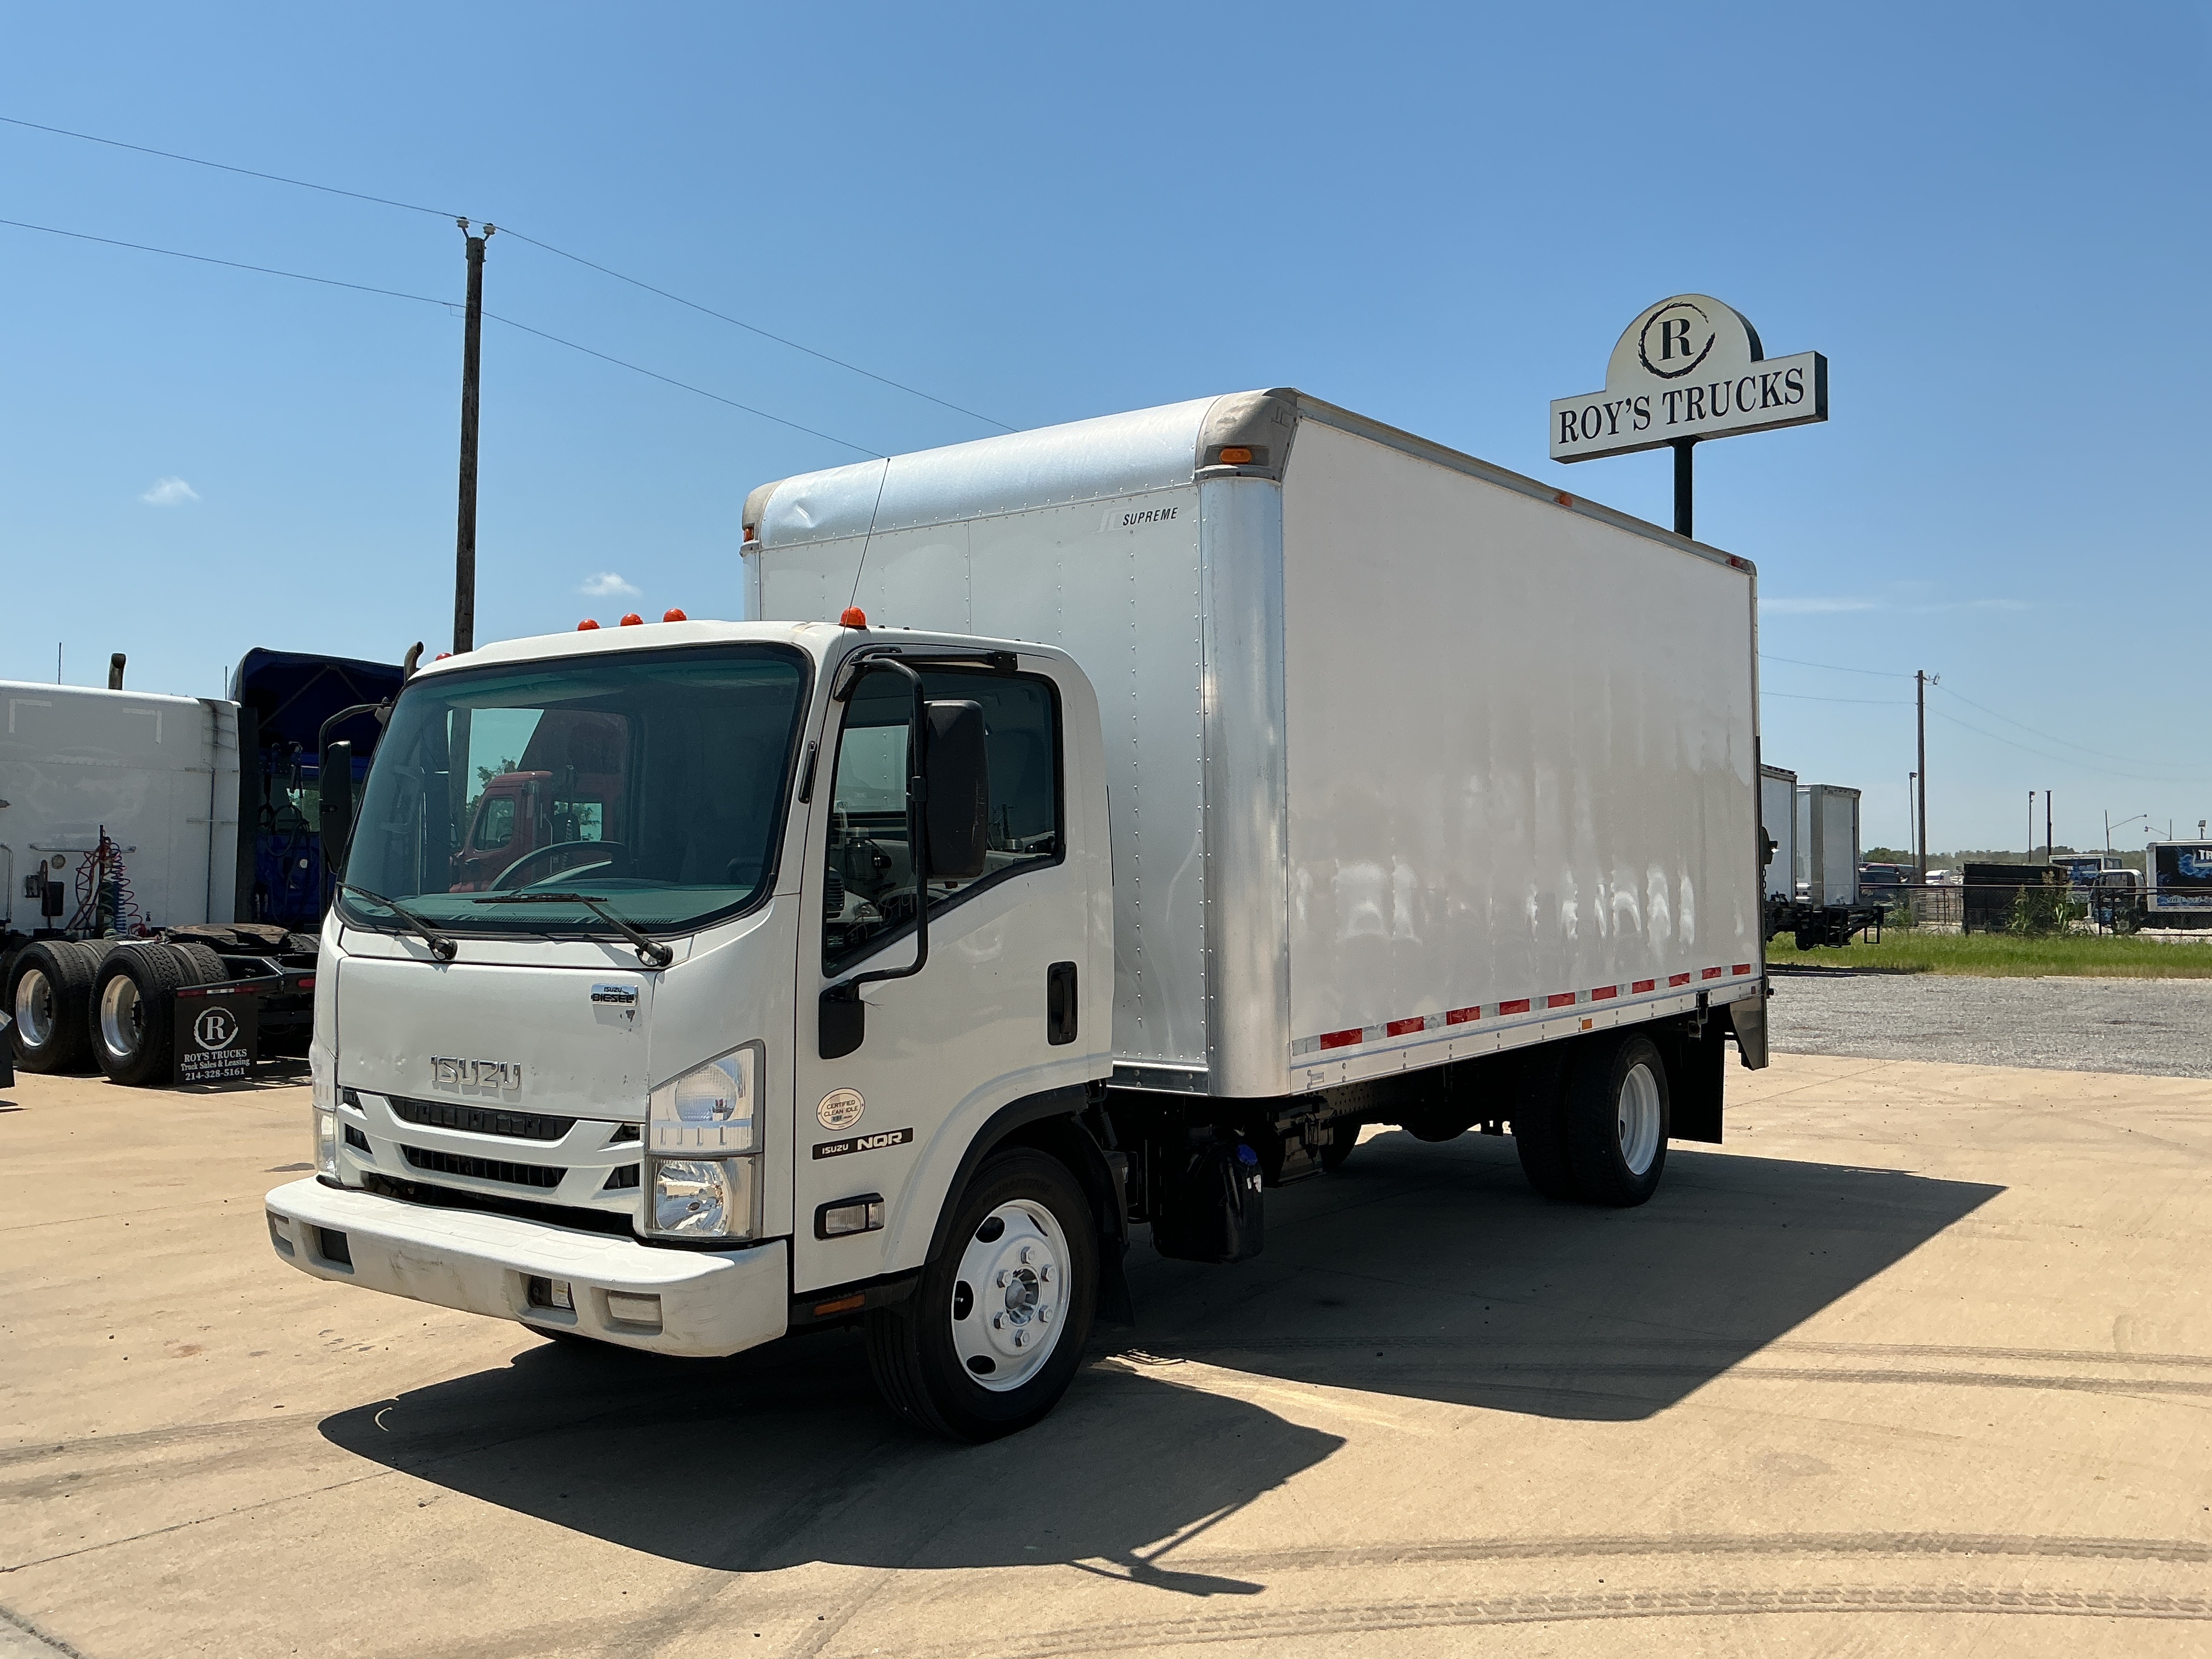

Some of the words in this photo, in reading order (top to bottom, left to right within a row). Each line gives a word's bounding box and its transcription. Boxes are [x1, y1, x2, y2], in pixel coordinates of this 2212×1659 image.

[1658, 318, 1695, 362] R
[1558, 394, 1651, 444] ROY'S
[1662, 367, 1804, 426] TRUCKS
[1122, 507, 1178, 526] SUPREME
[592, 994, 633, 1003] DIESEL
[204, 1016, 226, 1040] R
[180, 1063, 198, 1071] Truck
[199, 1061, 217, 1069] Sales
[224, 1057, 251, 1067] Leasing
[184, 1052, 210, 1063] ROY'S
[211, 1048, 247, 1060] TRUCKS
[185, 1067, 245, 1081] 214-328-5161
[430, 1054, 522, 1091] ISUZU
[823, 1109, 844, 1117] CLEAN
[826, 1099, 856, 1110] CERTIFIED
[822, 1143, 849, 1155] ISUZU
[857, 1132, 903, 1151] NQR
